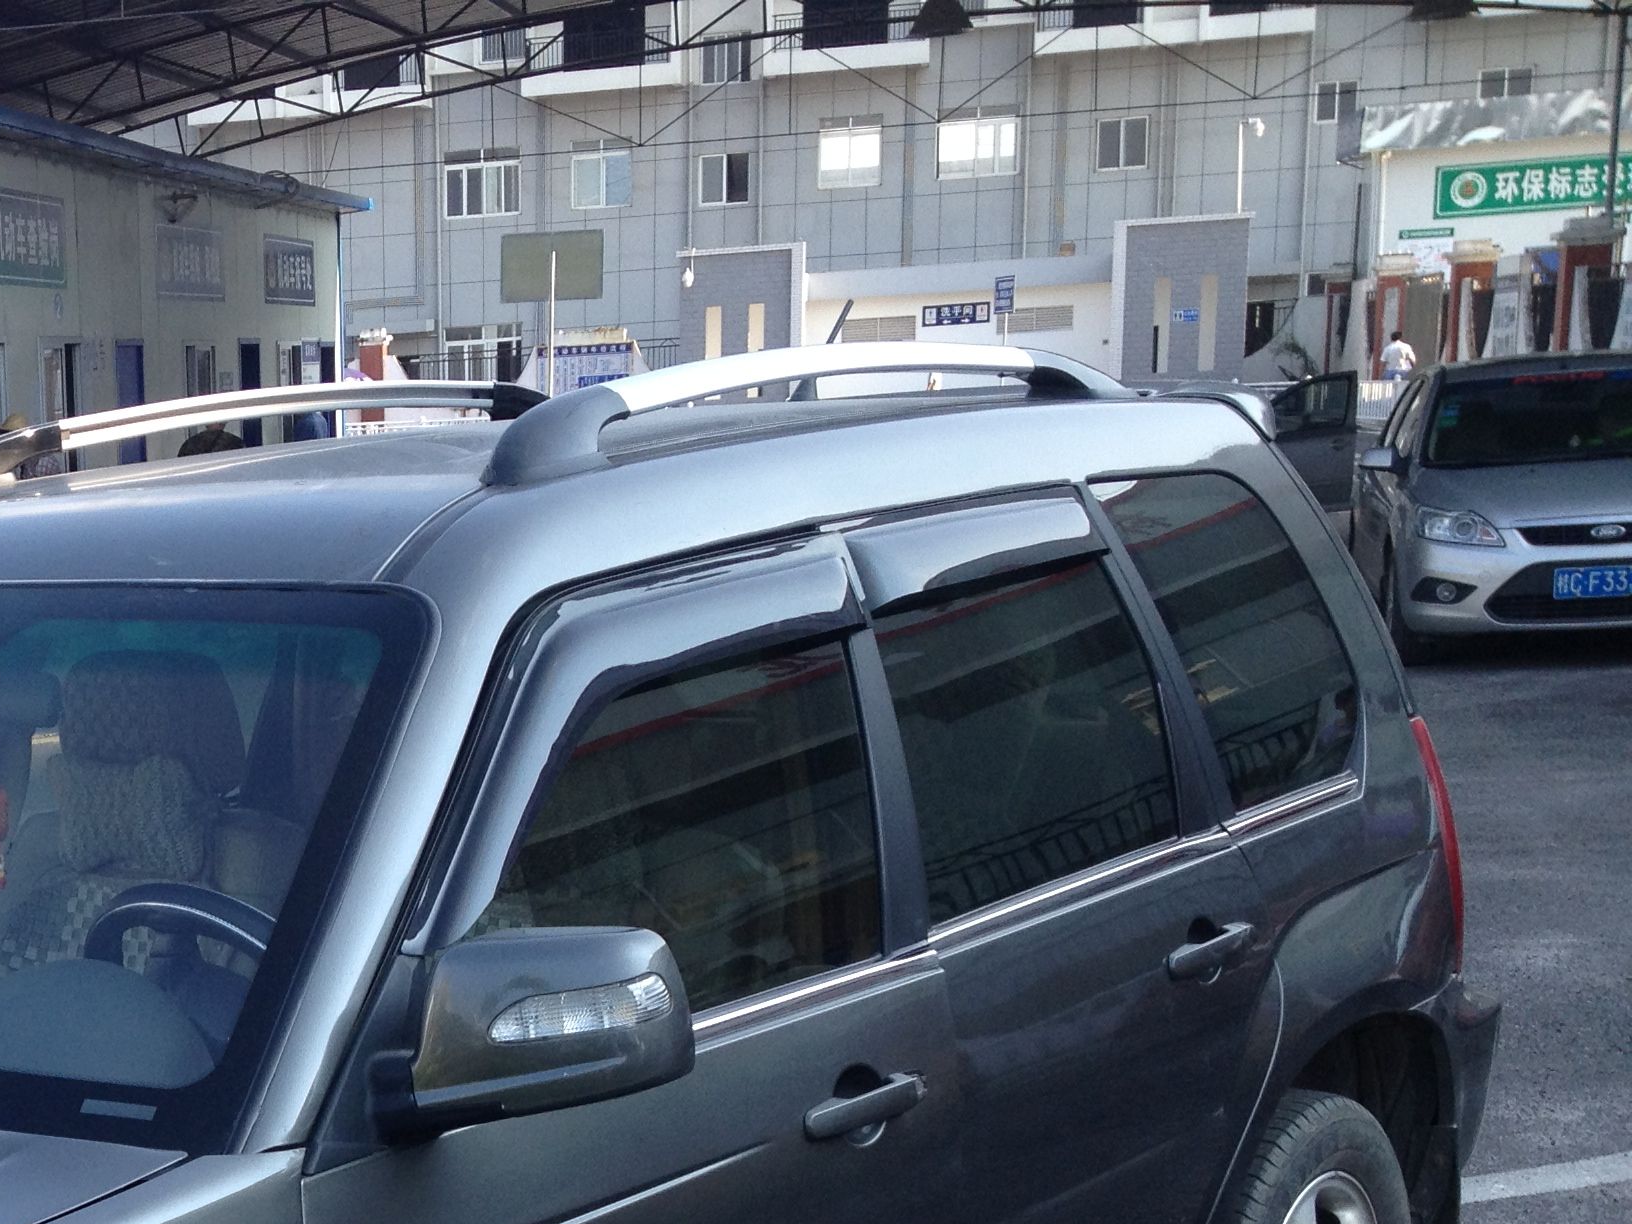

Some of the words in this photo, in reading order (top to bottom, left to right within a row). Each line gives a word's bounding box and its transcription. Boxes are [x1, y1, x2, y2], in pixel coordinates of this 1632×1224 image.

[1494, 160, 1632, 205] 环保标志受
